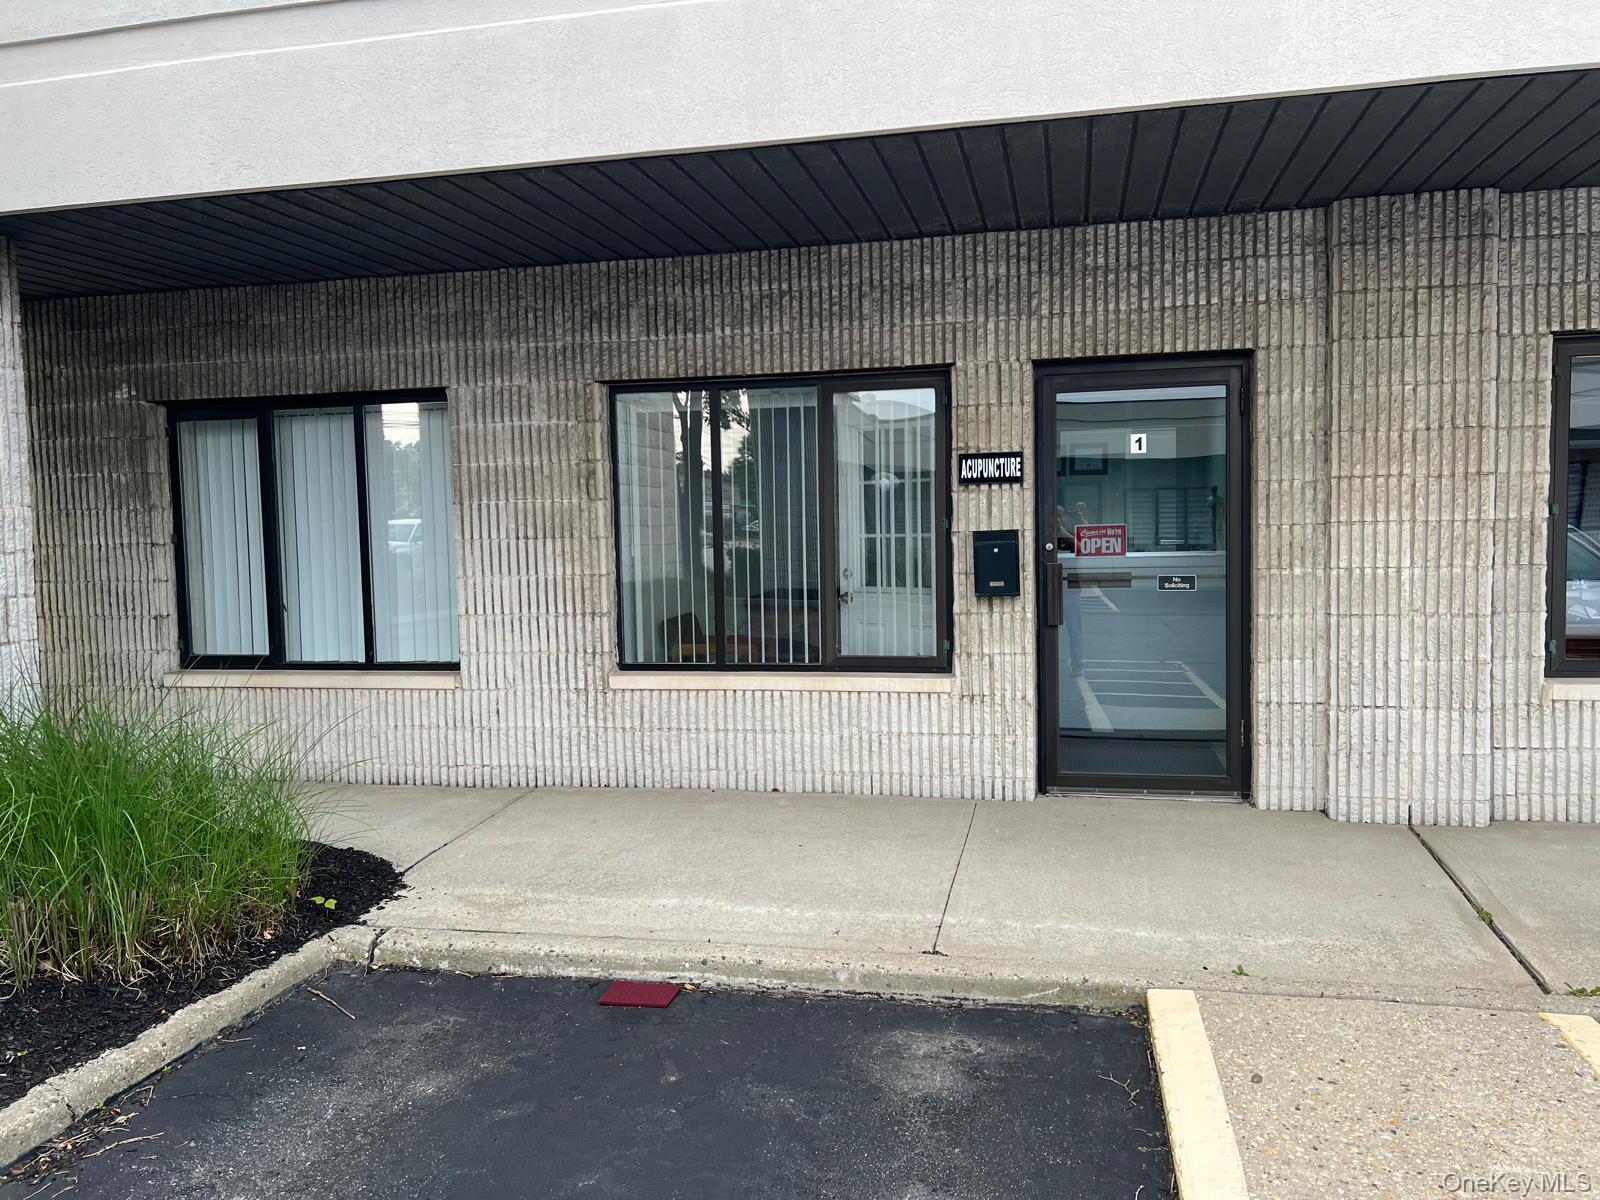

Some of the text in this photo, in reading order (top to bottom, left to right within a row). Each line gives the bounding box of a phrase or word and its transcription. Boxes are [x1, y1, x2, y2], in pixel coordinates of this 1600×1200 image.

[1134, 437, 1143, 450] 1
[961, 457, 1021, 479] ACUPUNCTURE
[1080, 537, 1121, 554] OPEN
